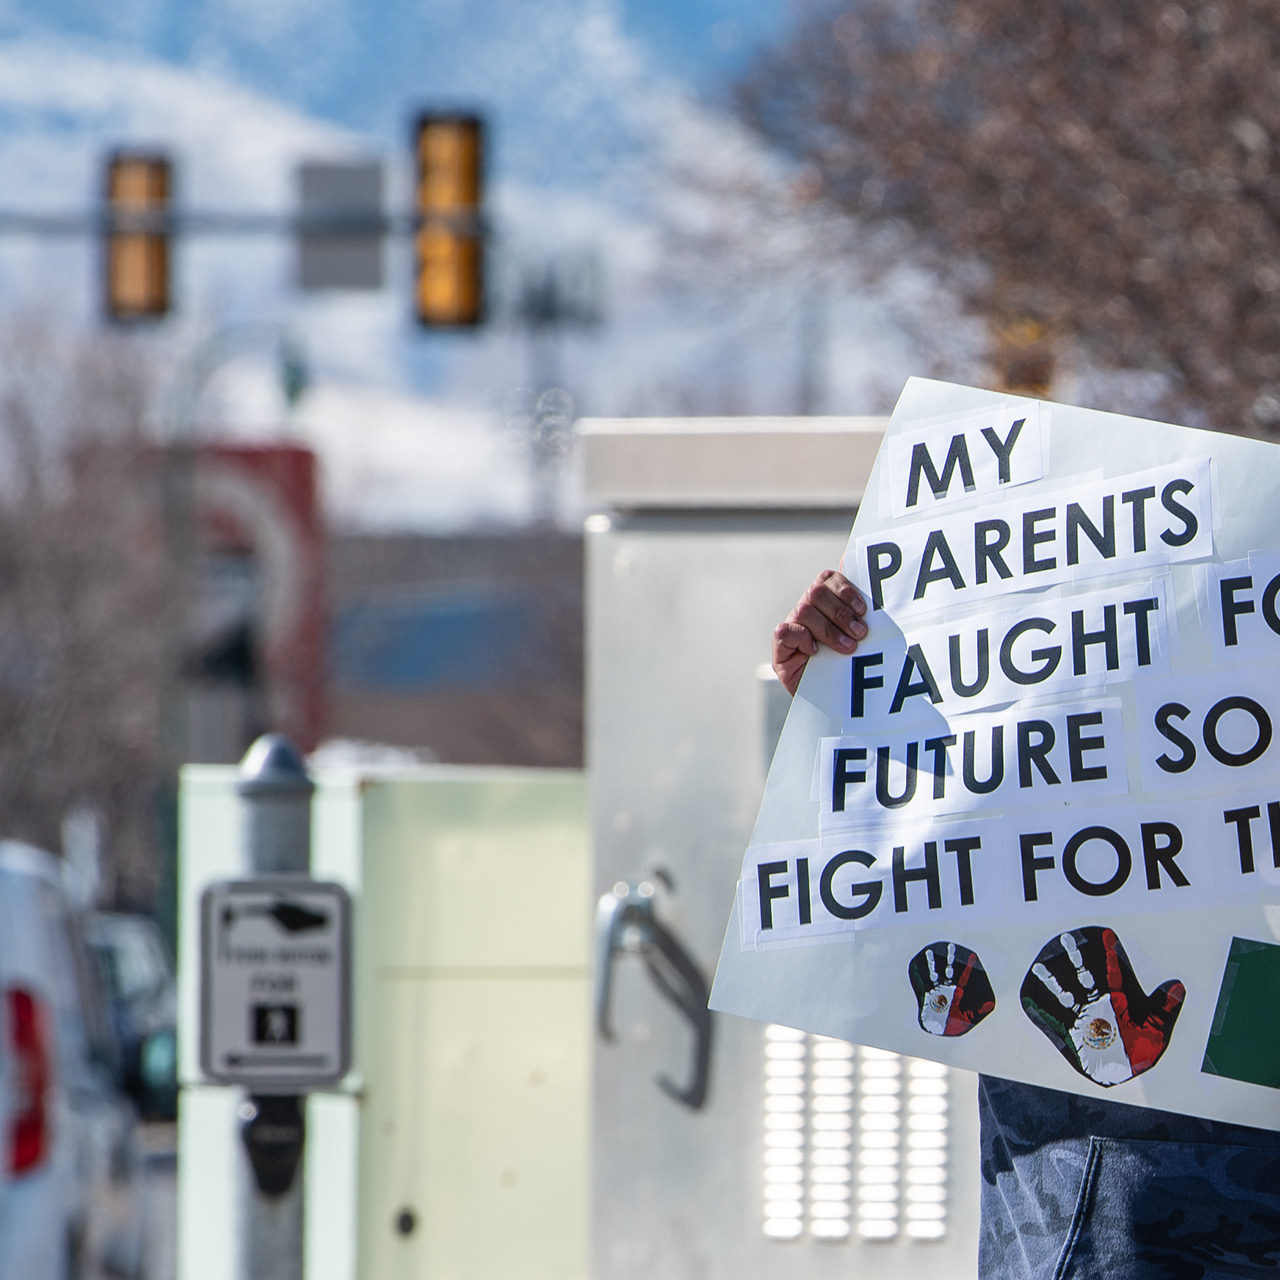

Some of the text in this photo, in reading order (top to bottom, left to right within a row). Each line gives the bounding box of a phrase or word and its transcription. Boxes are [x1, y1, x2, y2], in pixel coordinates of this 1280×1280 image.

[906, 418, 1027, 508] MY
[865, 478, 1200, 611] PARENTS
[850, 597, 1159, 718] FAUGHT
[832, 712, 1109, 812] FUTURE
[1155, 696, 1273, 773] SO
[756, 836, 983, 930] FIGHT
[1020, 822, 1190, 901] FOR
